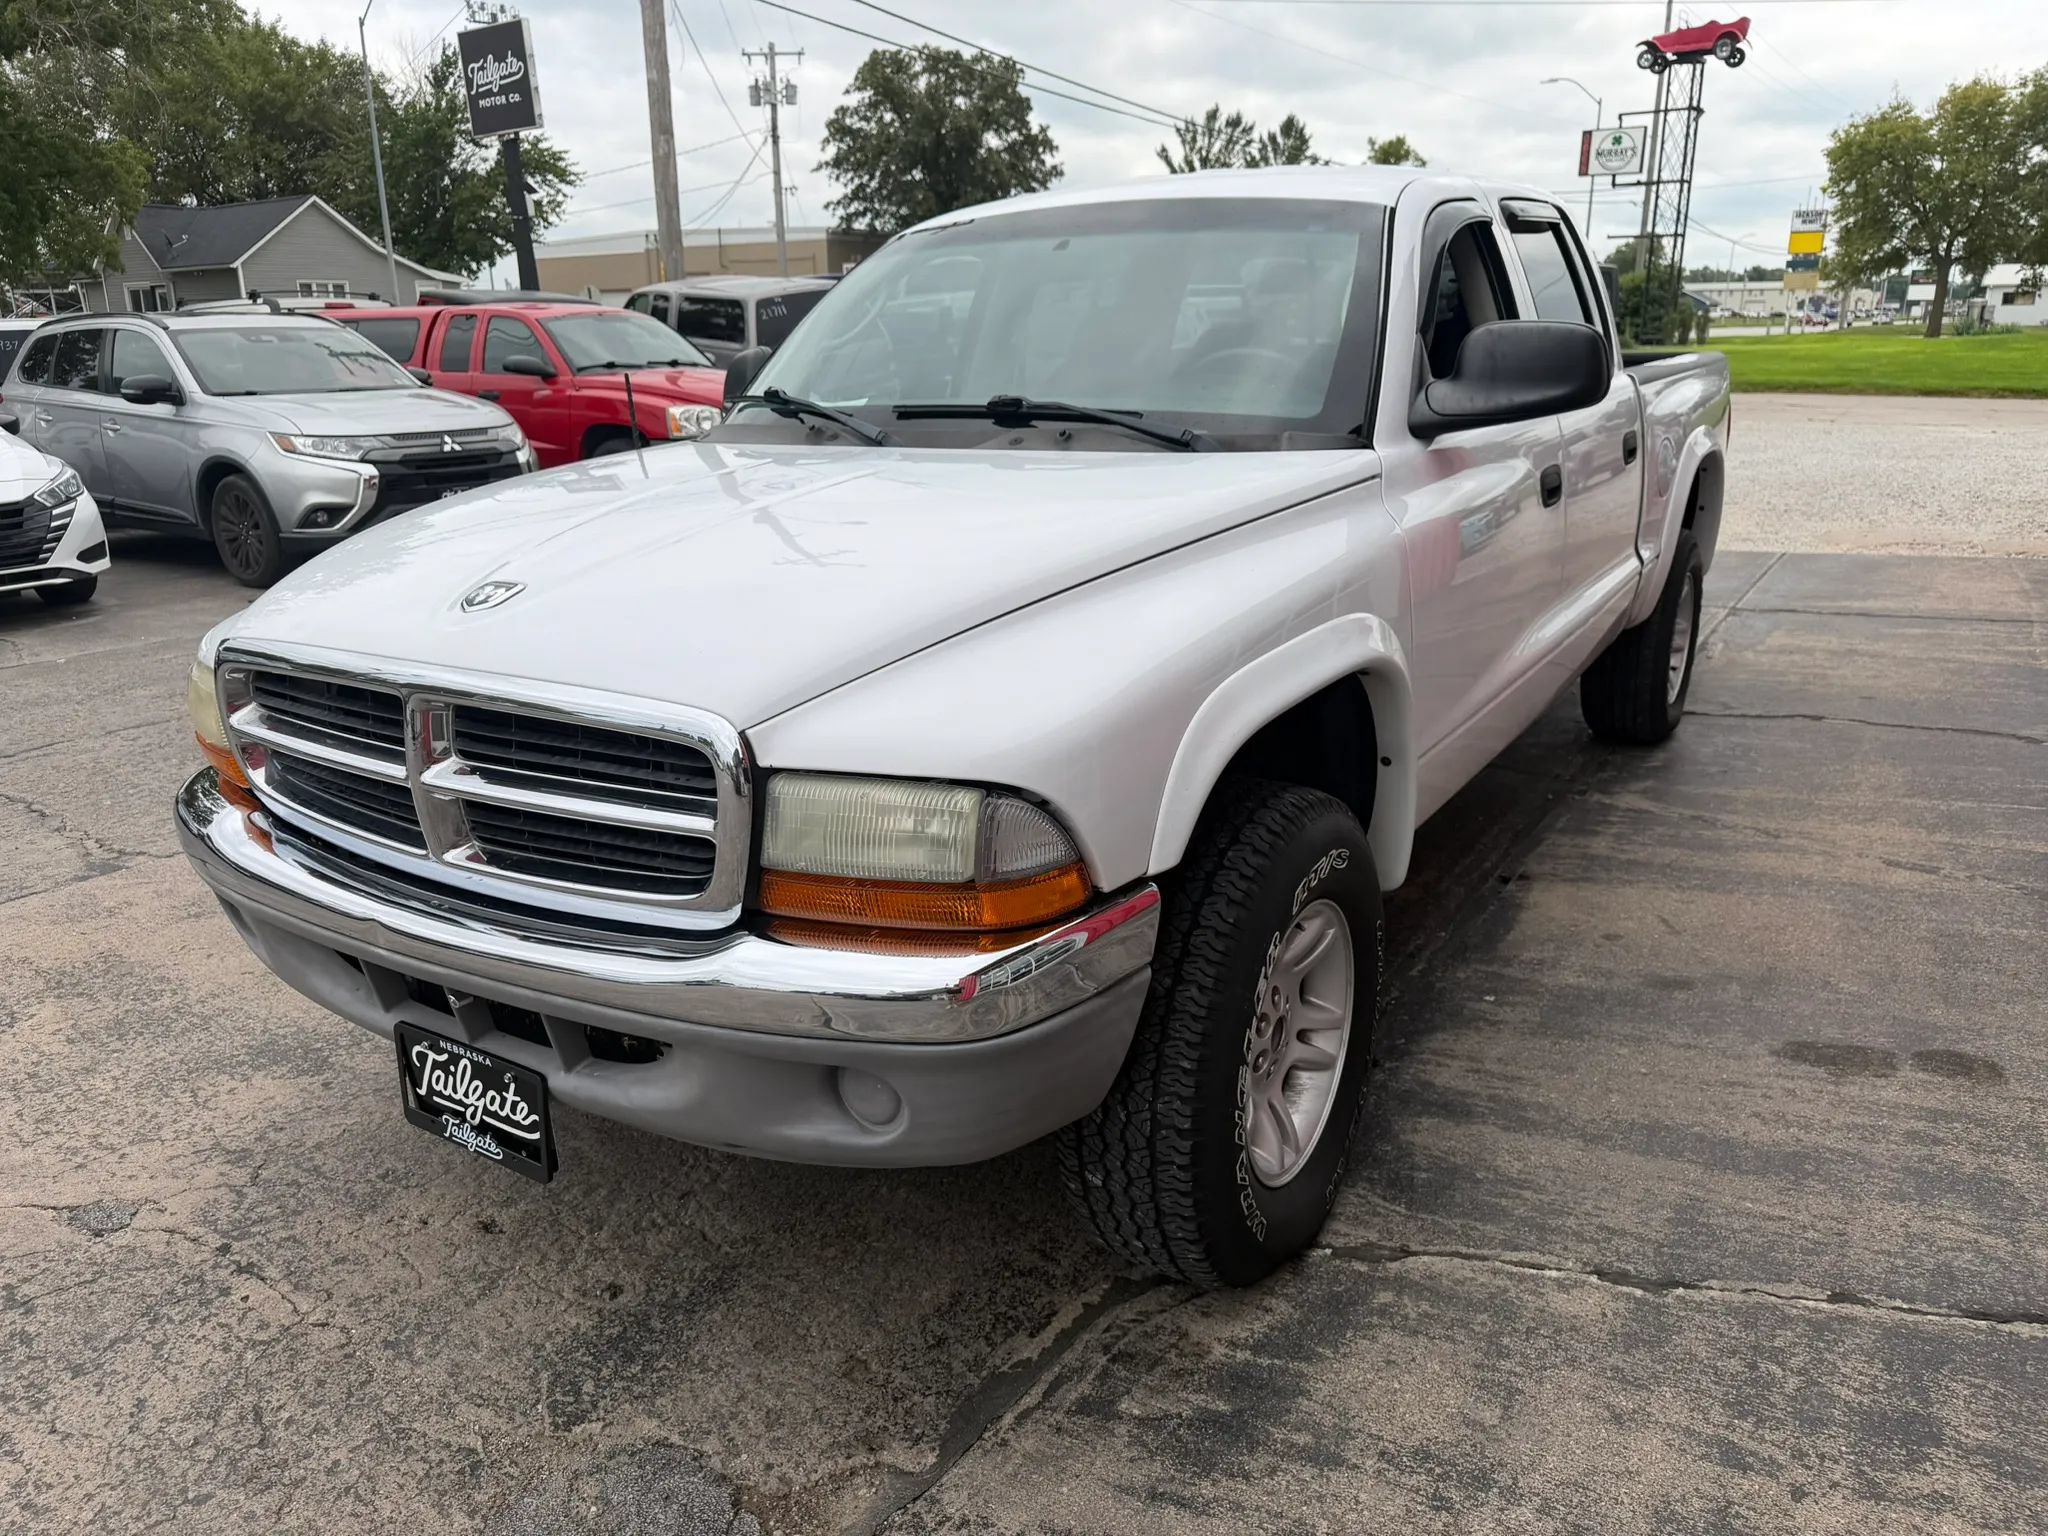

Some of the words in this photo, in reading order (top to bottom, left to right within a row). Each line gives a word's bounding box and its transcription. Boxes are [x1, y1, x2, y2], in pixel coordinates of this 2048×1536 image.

[468, 50, 524, 95] Tailgate
[479, 94, 507, 108] MOTOR
[508, 93, 522, 103] CO.
[1595, 146, 1637, 160] MURRAY'S
[439, 1039, 493, 1067] NEBRASKA
[412, 1044, 541, 1140] Tailgate
[442, 1114, 503, 1160] Tailgate
